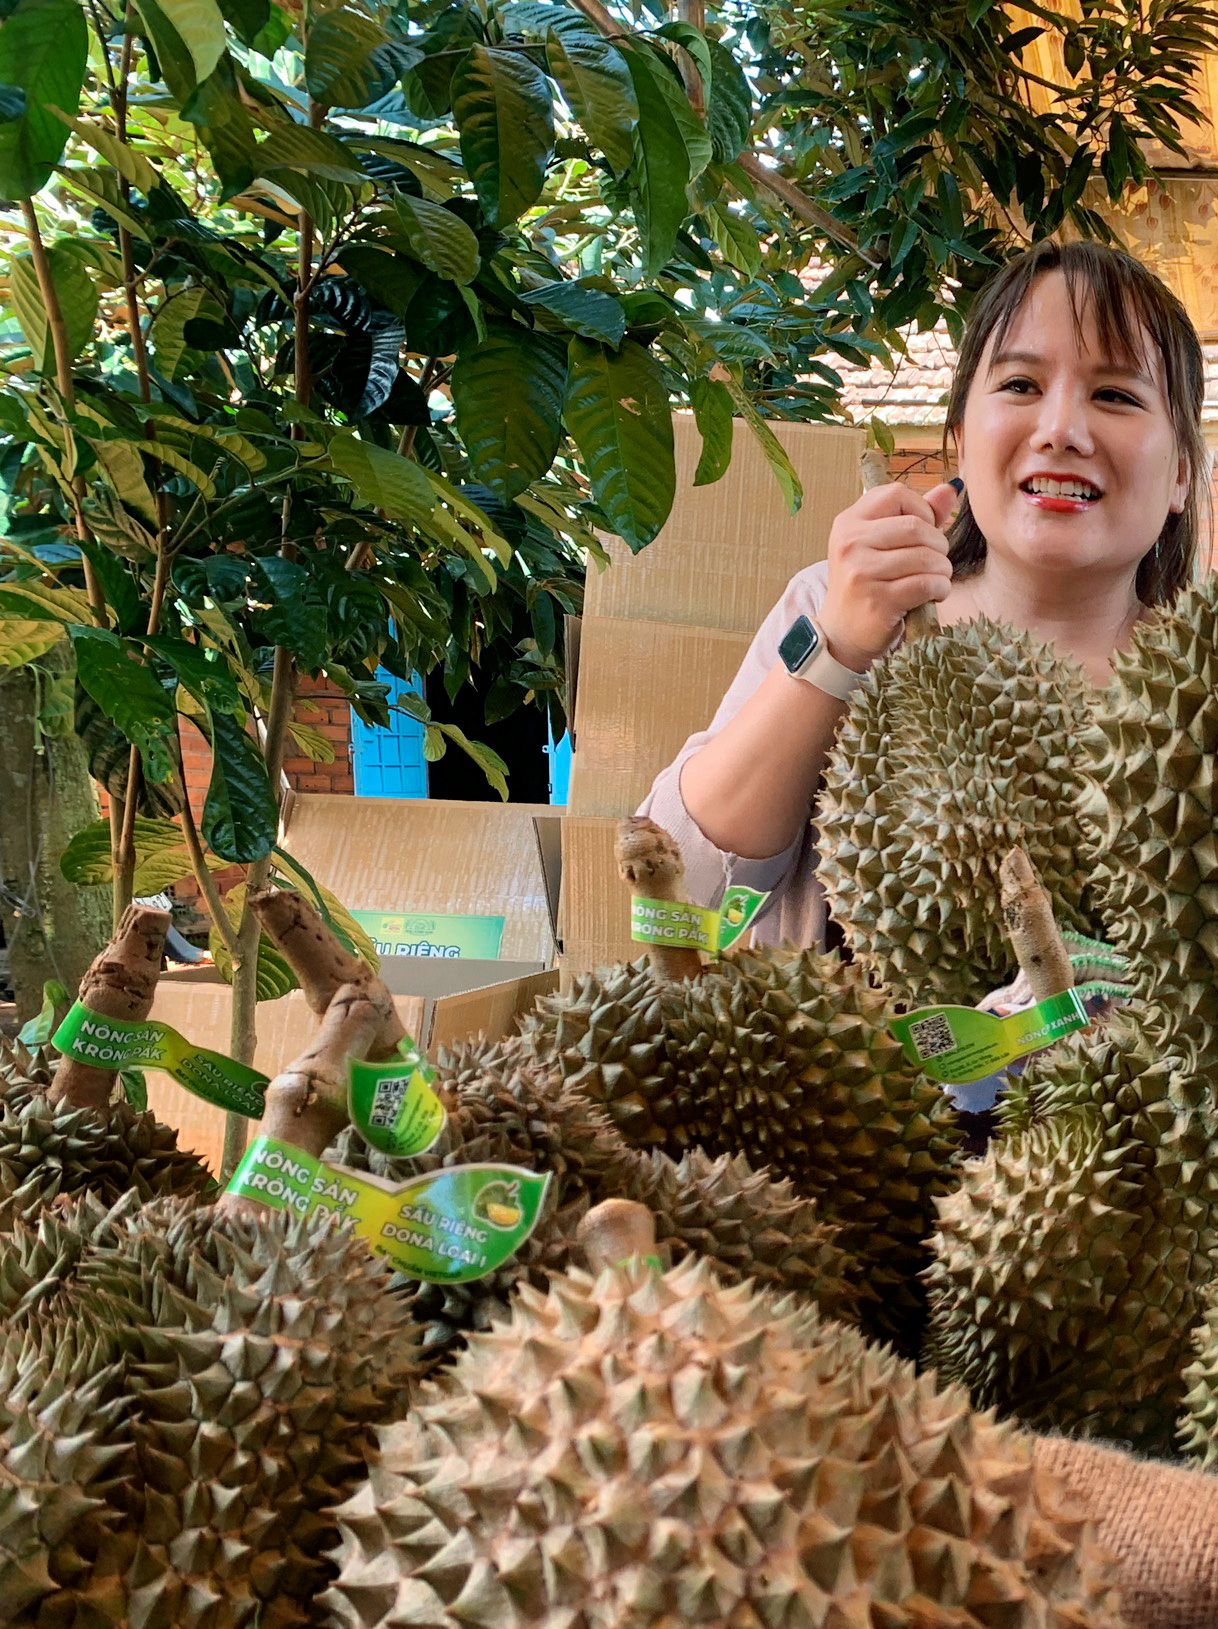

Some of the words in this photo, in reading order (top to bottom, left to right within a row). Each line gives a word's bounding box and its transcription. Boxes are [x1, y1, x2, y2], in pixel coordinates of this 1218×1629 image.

[633, 921, 674, 938] RÔNG
[671, 907, 701, 926] SẢN
[182, 1059, 220, 1090] DONA
[241, 1171, 310, 1213] KRÔNG
[252, 1150, 310, 1184] NÔNG
[311, 1178, 357, 1206] SẢN
[381, 1222, 434, 1251] DONA
[438, 1216, 488, 1244] RIÊNG
